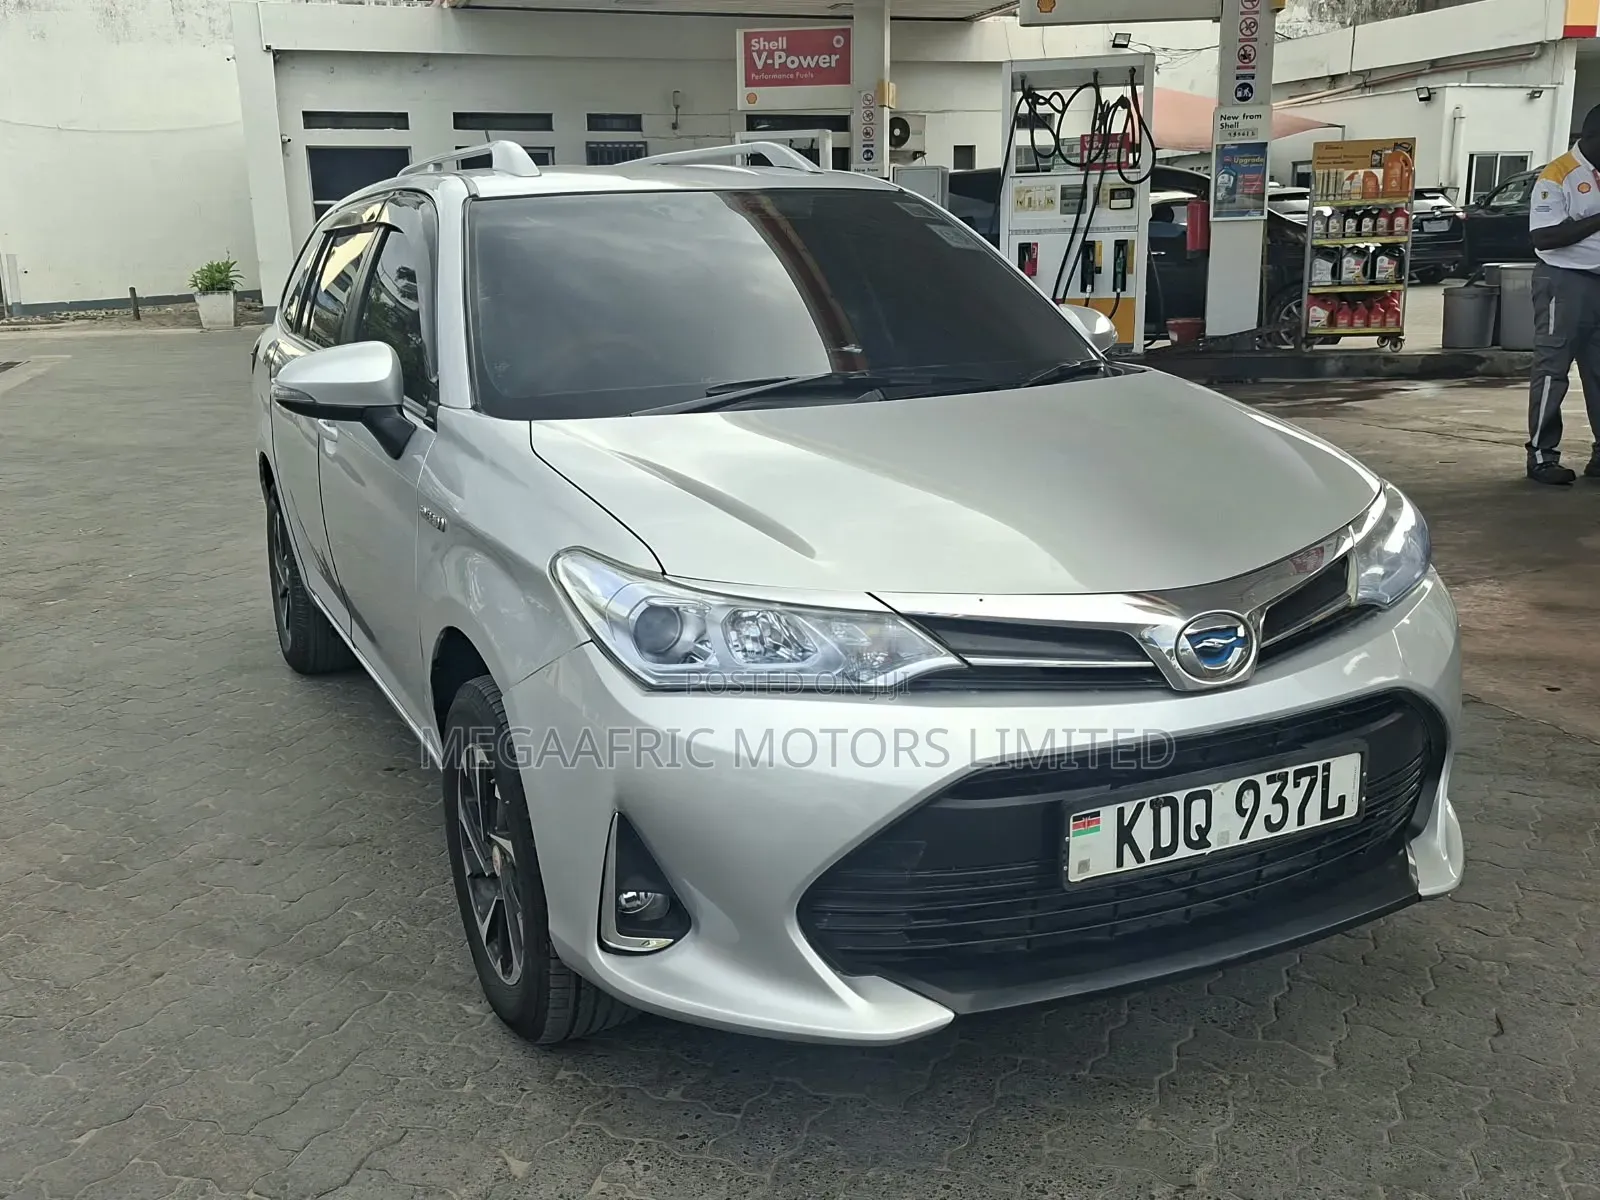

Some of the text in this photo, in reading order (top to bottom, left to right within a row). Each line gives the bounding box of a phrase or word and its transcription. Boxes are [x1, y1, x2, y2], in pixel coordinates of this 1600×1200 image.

[751, 36, 787, 51] Shell
[752, 51, 840, 70] V-Power
[751, 71, 814, 80] Performance Fuels
[1242, 112, 1262, 120] from
[1220, 121, 1240, 130] Shell
[1233, 156, 1264, 165] Upgrade
[1116, 788, 1213, 868] KDQ
[1235, 762, 1346, 840] 937L
